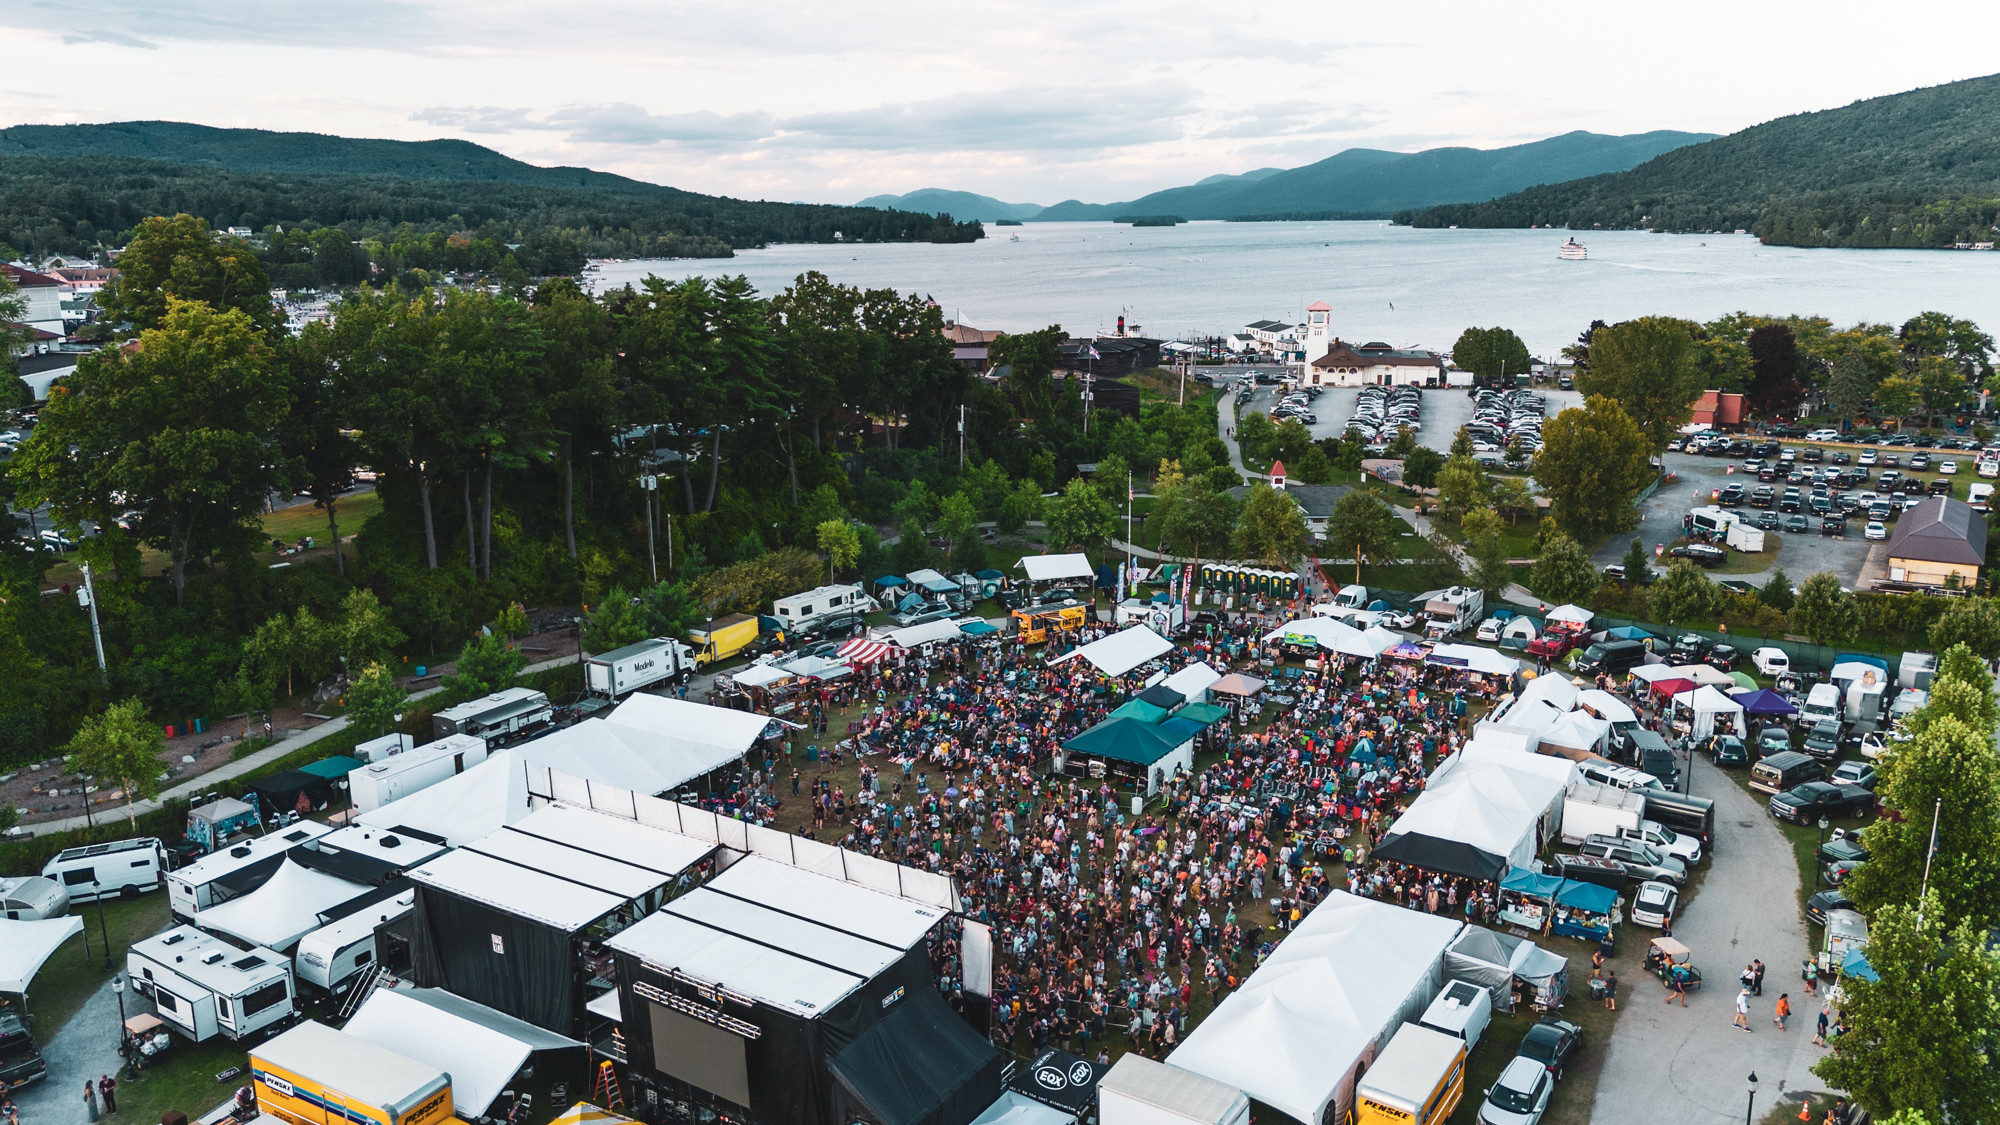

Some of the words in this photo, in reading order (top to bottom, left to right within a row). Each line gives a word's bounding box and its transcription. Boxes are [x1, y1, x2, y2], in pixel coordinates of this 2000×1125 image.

[634, 659, 654, 672] Modelo
[1039, 1070, 1063, 1087] EQX
[1072, 1064, 1089, 1083] EQX
[267, 1077, 291, 1091] PENSKE
[404, 1093, 446, 1125] PENSKE
[1049, 1100, 1076, 1111] alternative
[1364, 1100, 1410, 1120] PENSKE
